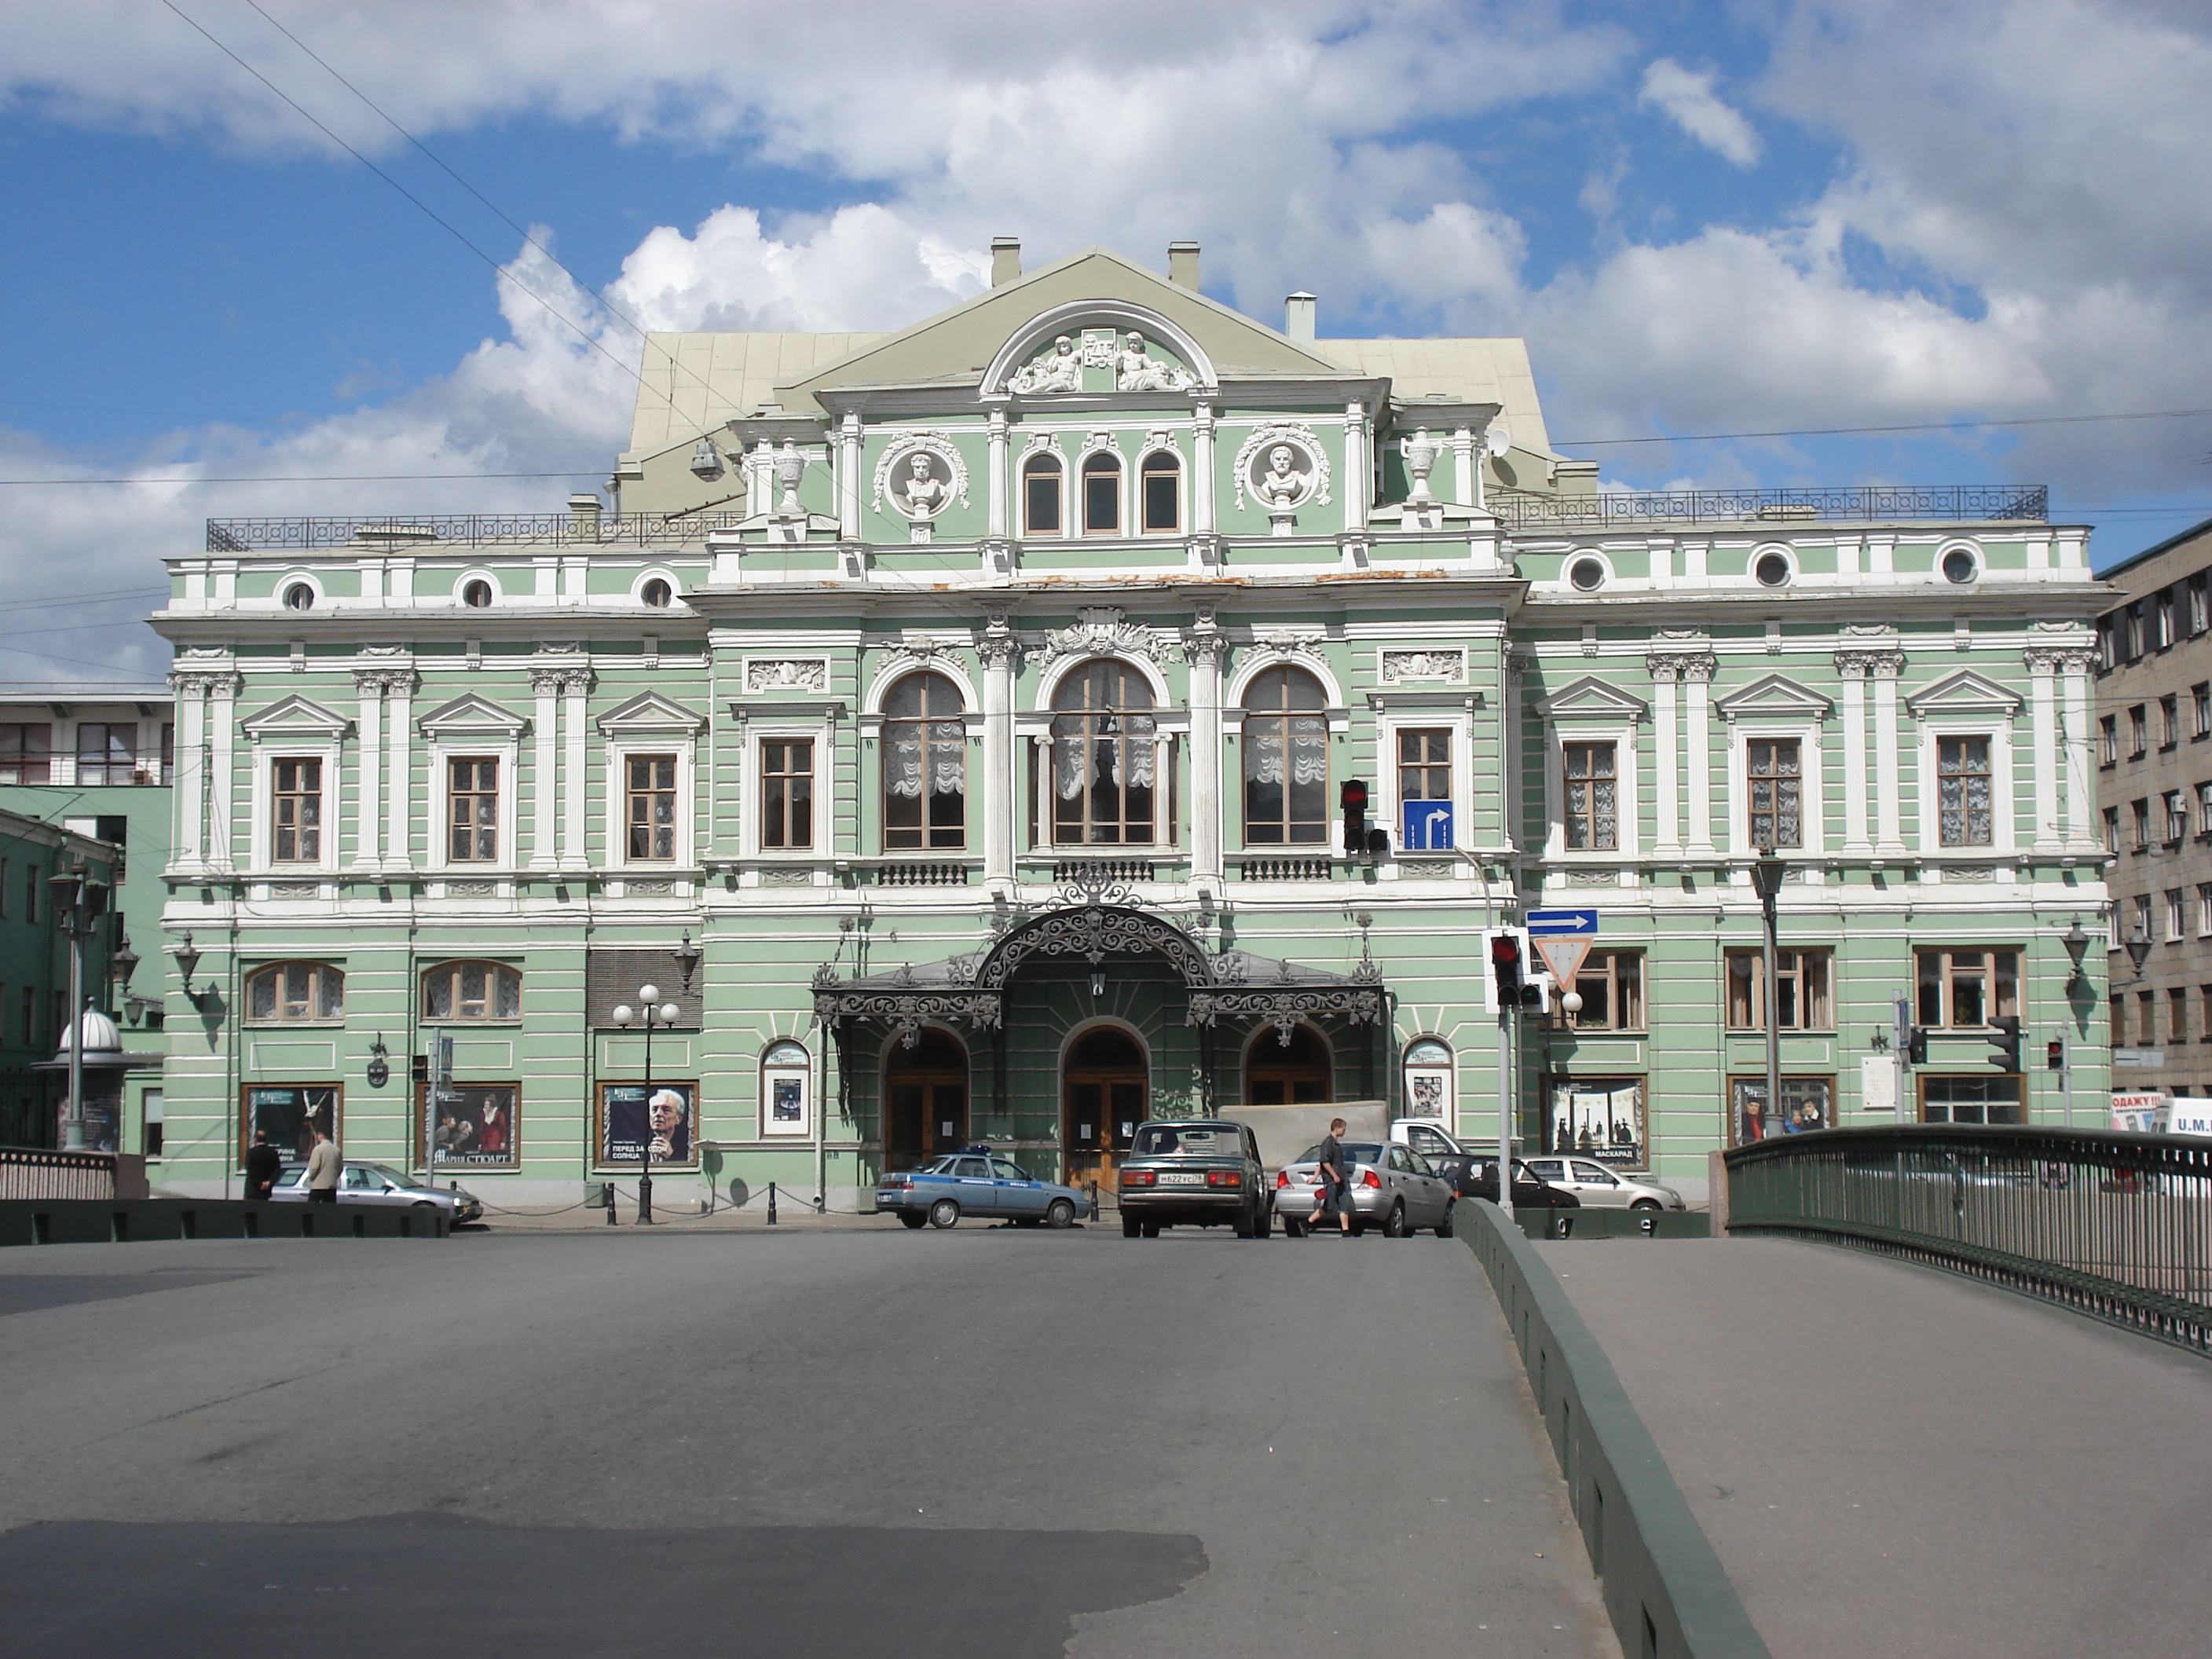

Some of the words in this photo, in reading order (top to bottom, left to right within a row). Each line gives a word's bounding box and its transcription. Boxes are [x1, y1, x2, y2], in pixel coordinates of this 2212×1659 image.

[2112, 1097, 2149, 1108] ОДАЖУ
[2178, 1119, 2212, 1131] U.M.
[467, 1155, 508, 1163] СТЮАРТ
